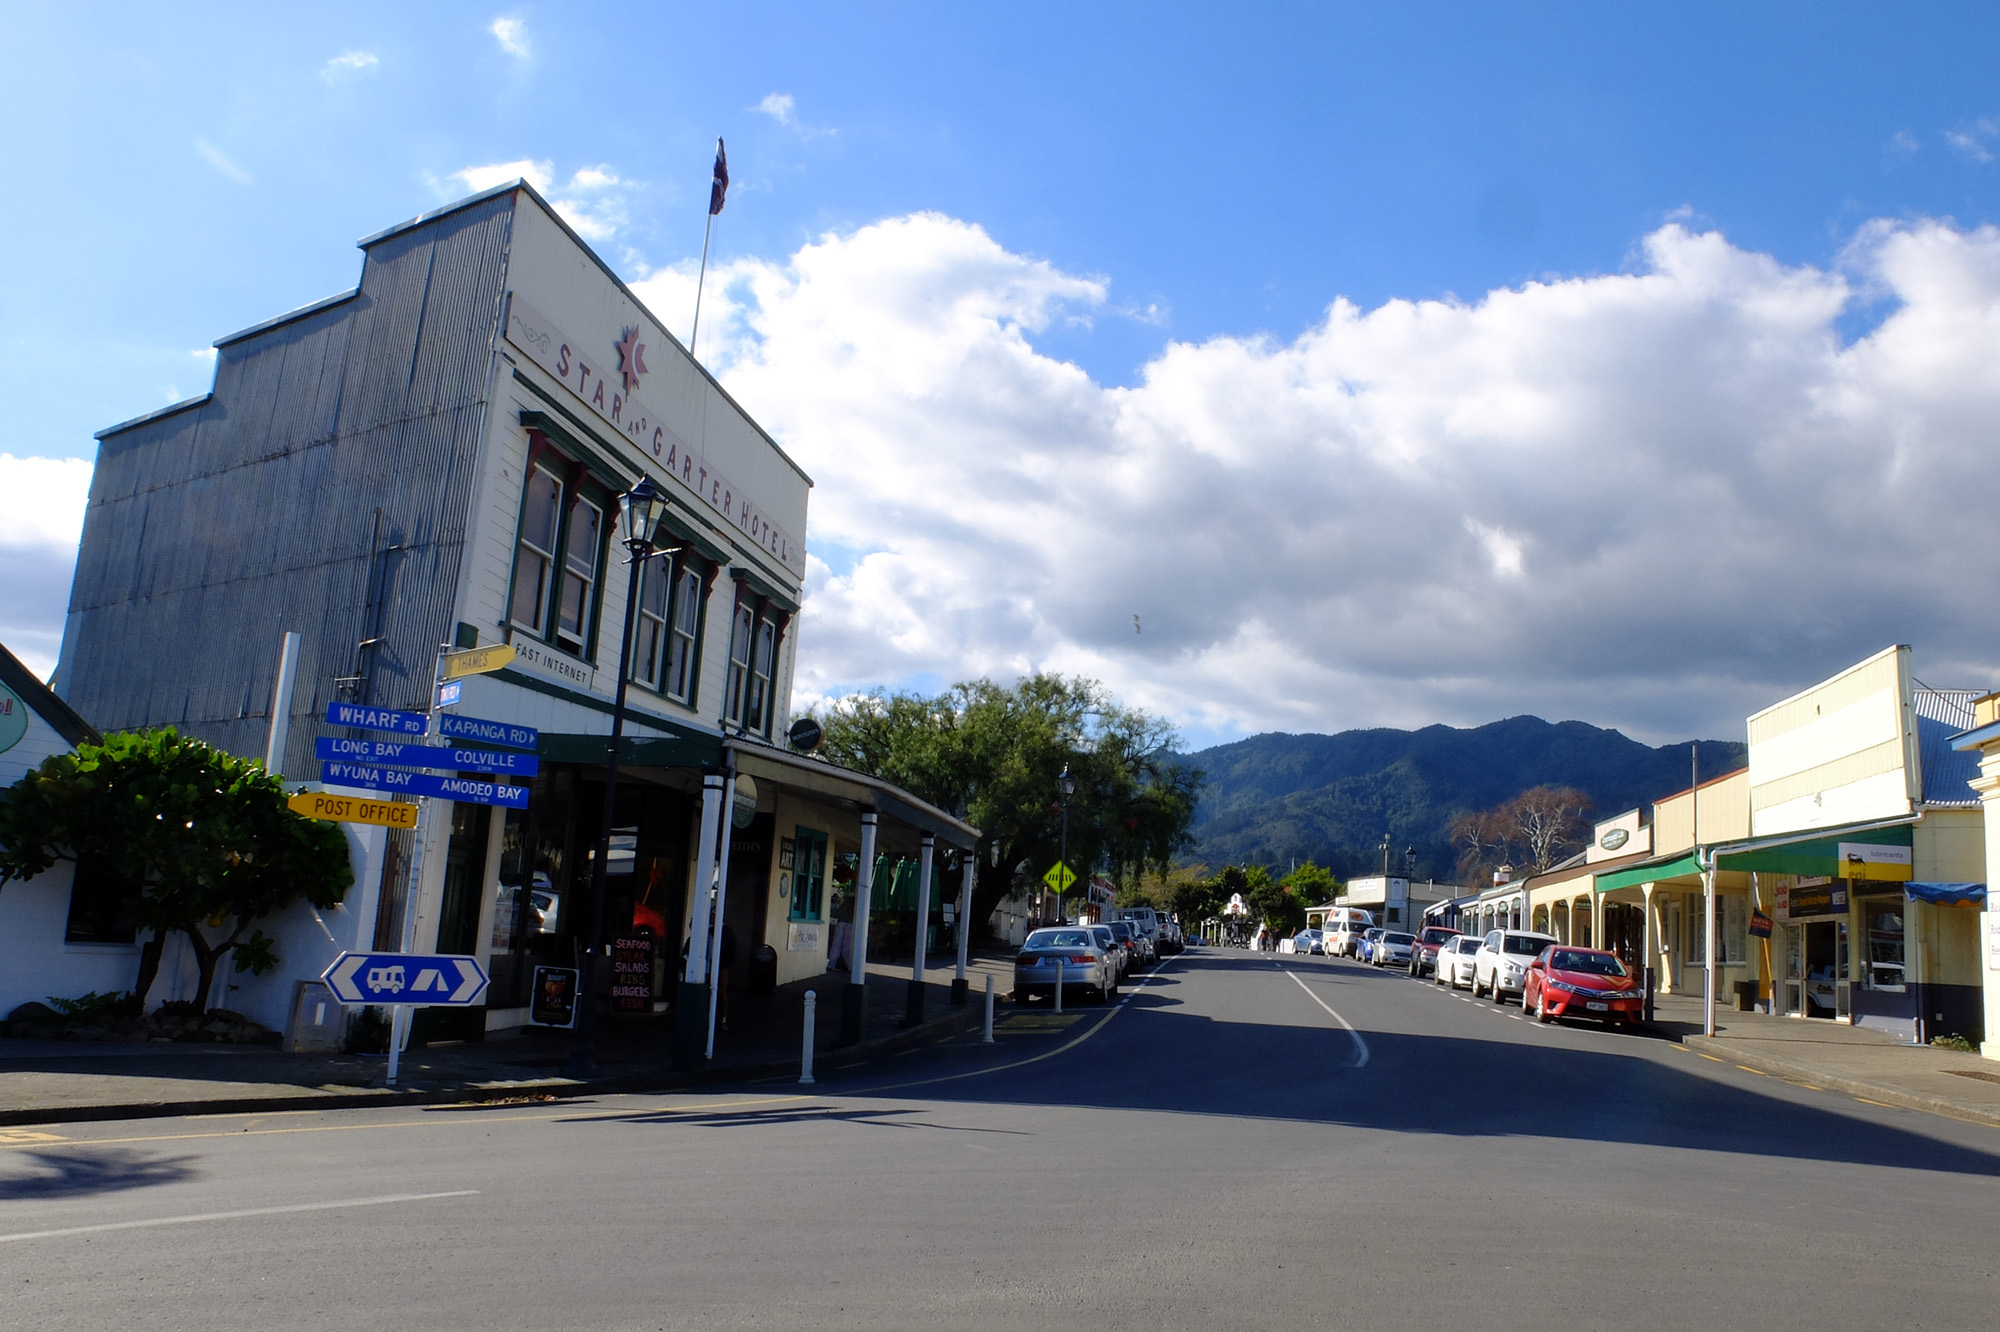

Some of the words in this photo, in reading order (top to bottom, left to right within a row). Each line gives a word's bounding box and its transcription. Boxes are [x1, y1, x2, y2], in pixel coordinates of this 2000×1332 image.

[556, 344, 622, 424] STAR
[628, 417, 647, 436] AND
[653, 427, 732, 515] GARTER
[741, 501, 787, 561] HOTEL
[457, 652, 489, 671] THAMES
[515, 642, 540, 662] FAST
[543, 655, 587, 683] INTERNET
[340, 706, 401, 728] WHARF
[404, 721, 420, 732] RD
[443, 718, 506, 740] KAPANGA
[510, 729, 527, 743] RD
[332, 739, 369, 755] LONG
[375, 743, 403, 757] BAY
[454, 750, 515, 767] COLVILLE
[330, 763, 380, 781] WYUNA
[386, 771, 413, 785] BAY
[441, 779, 493, 797] AMODEO
[497, 786, 522, 800] BAY
[315, 798, 352, 817] POST
[360, 803, 408, 823] OFFICE
[780, 851, 794, 869] ART
[1870, 850, 1903, 858] lubricants
[615, 938, 651, 951] SEAFOOD
[616, 951, 646, 962] STEAK
[614, 962, 650, 973] SALADS
[620, 974, 646, 986] RIBS
[612, 986, 650, 998] BURGERS
[621, 998, 645, 1008] FISH
